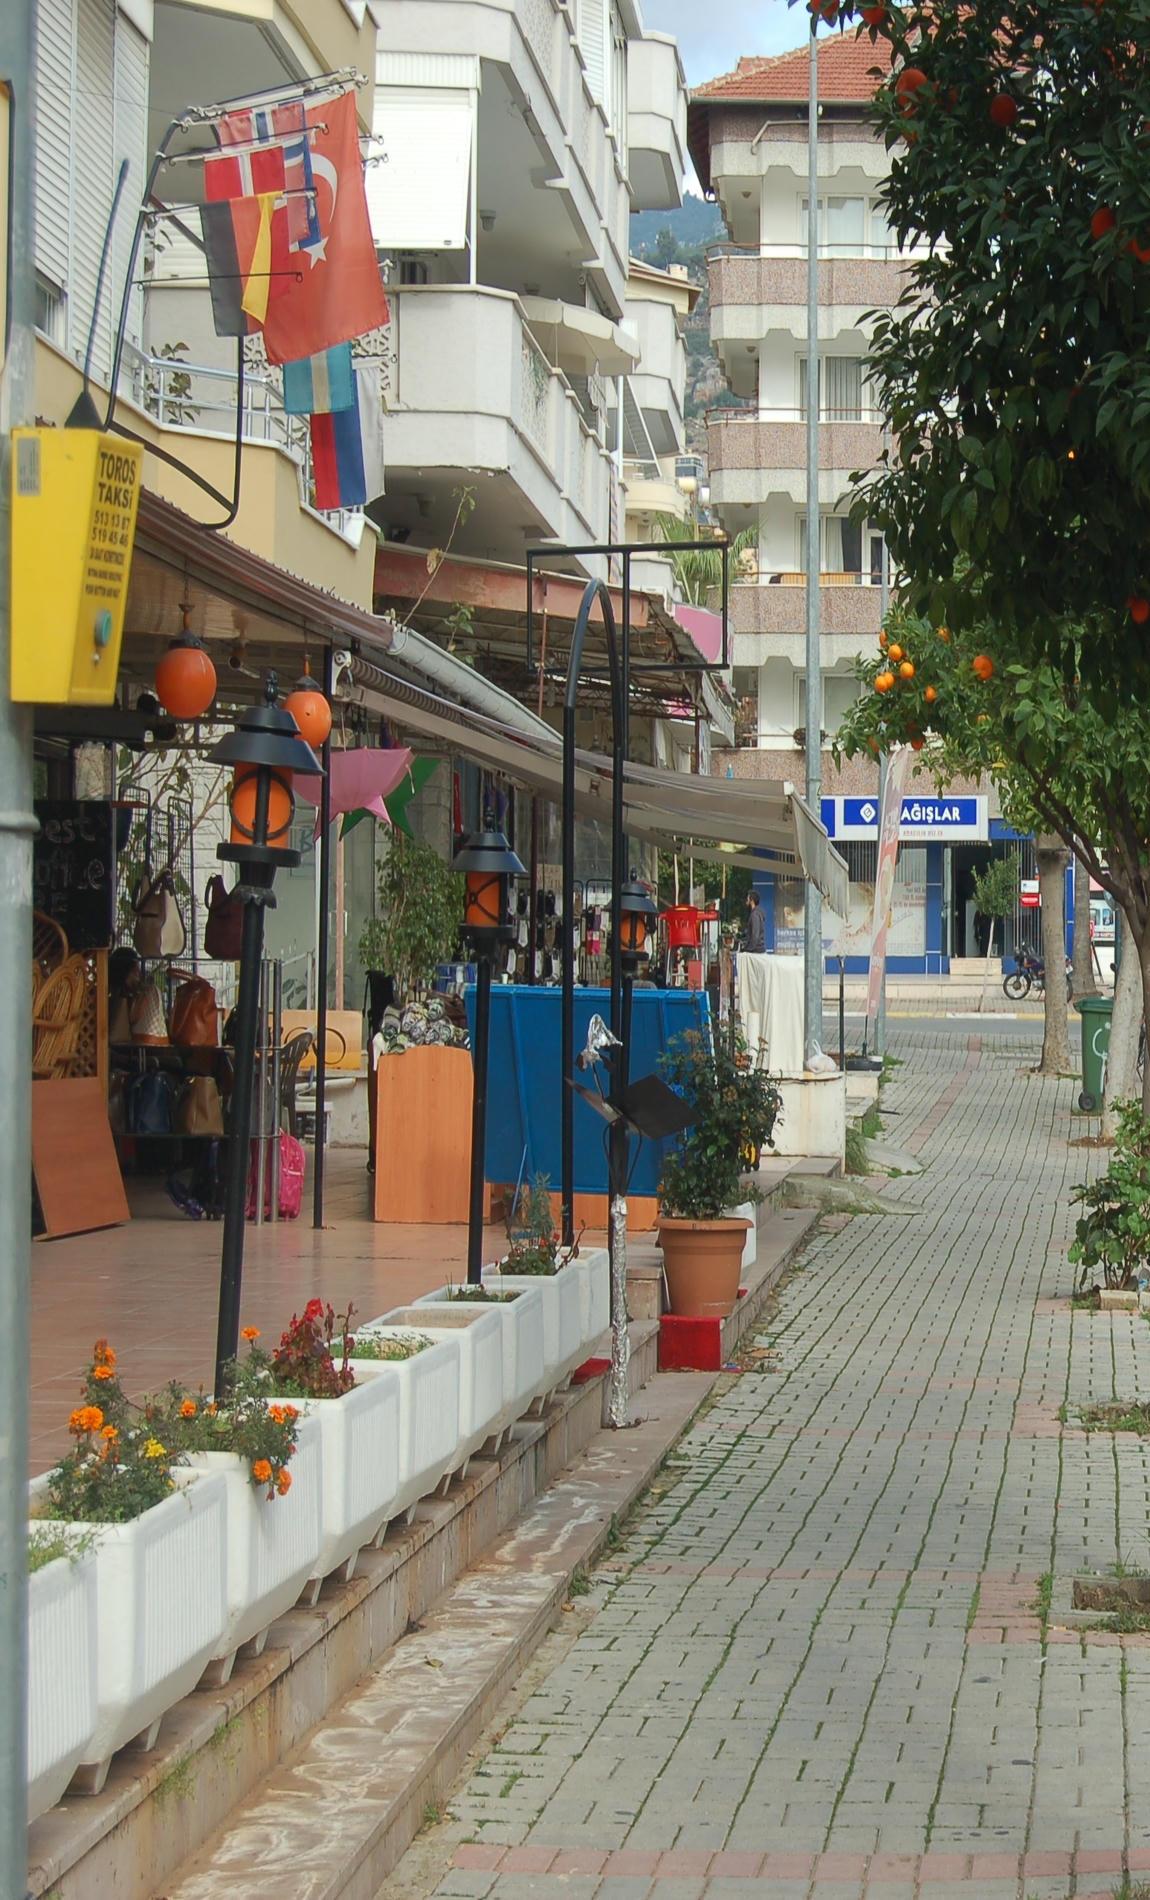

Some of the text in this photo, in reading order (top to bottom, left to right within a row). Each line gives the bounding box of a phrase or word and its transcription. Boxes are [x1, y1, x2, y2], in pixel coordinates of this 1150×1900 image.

[100, 451, 136, 486] TOROS
[94, 510, 109, 526] 513
[111, 513, 120, 528] 13
[91, 526, 107, 543] 519
[109, 530, 118, 545] 45
[900, 804, 961, 823] AĞIŞLAR
